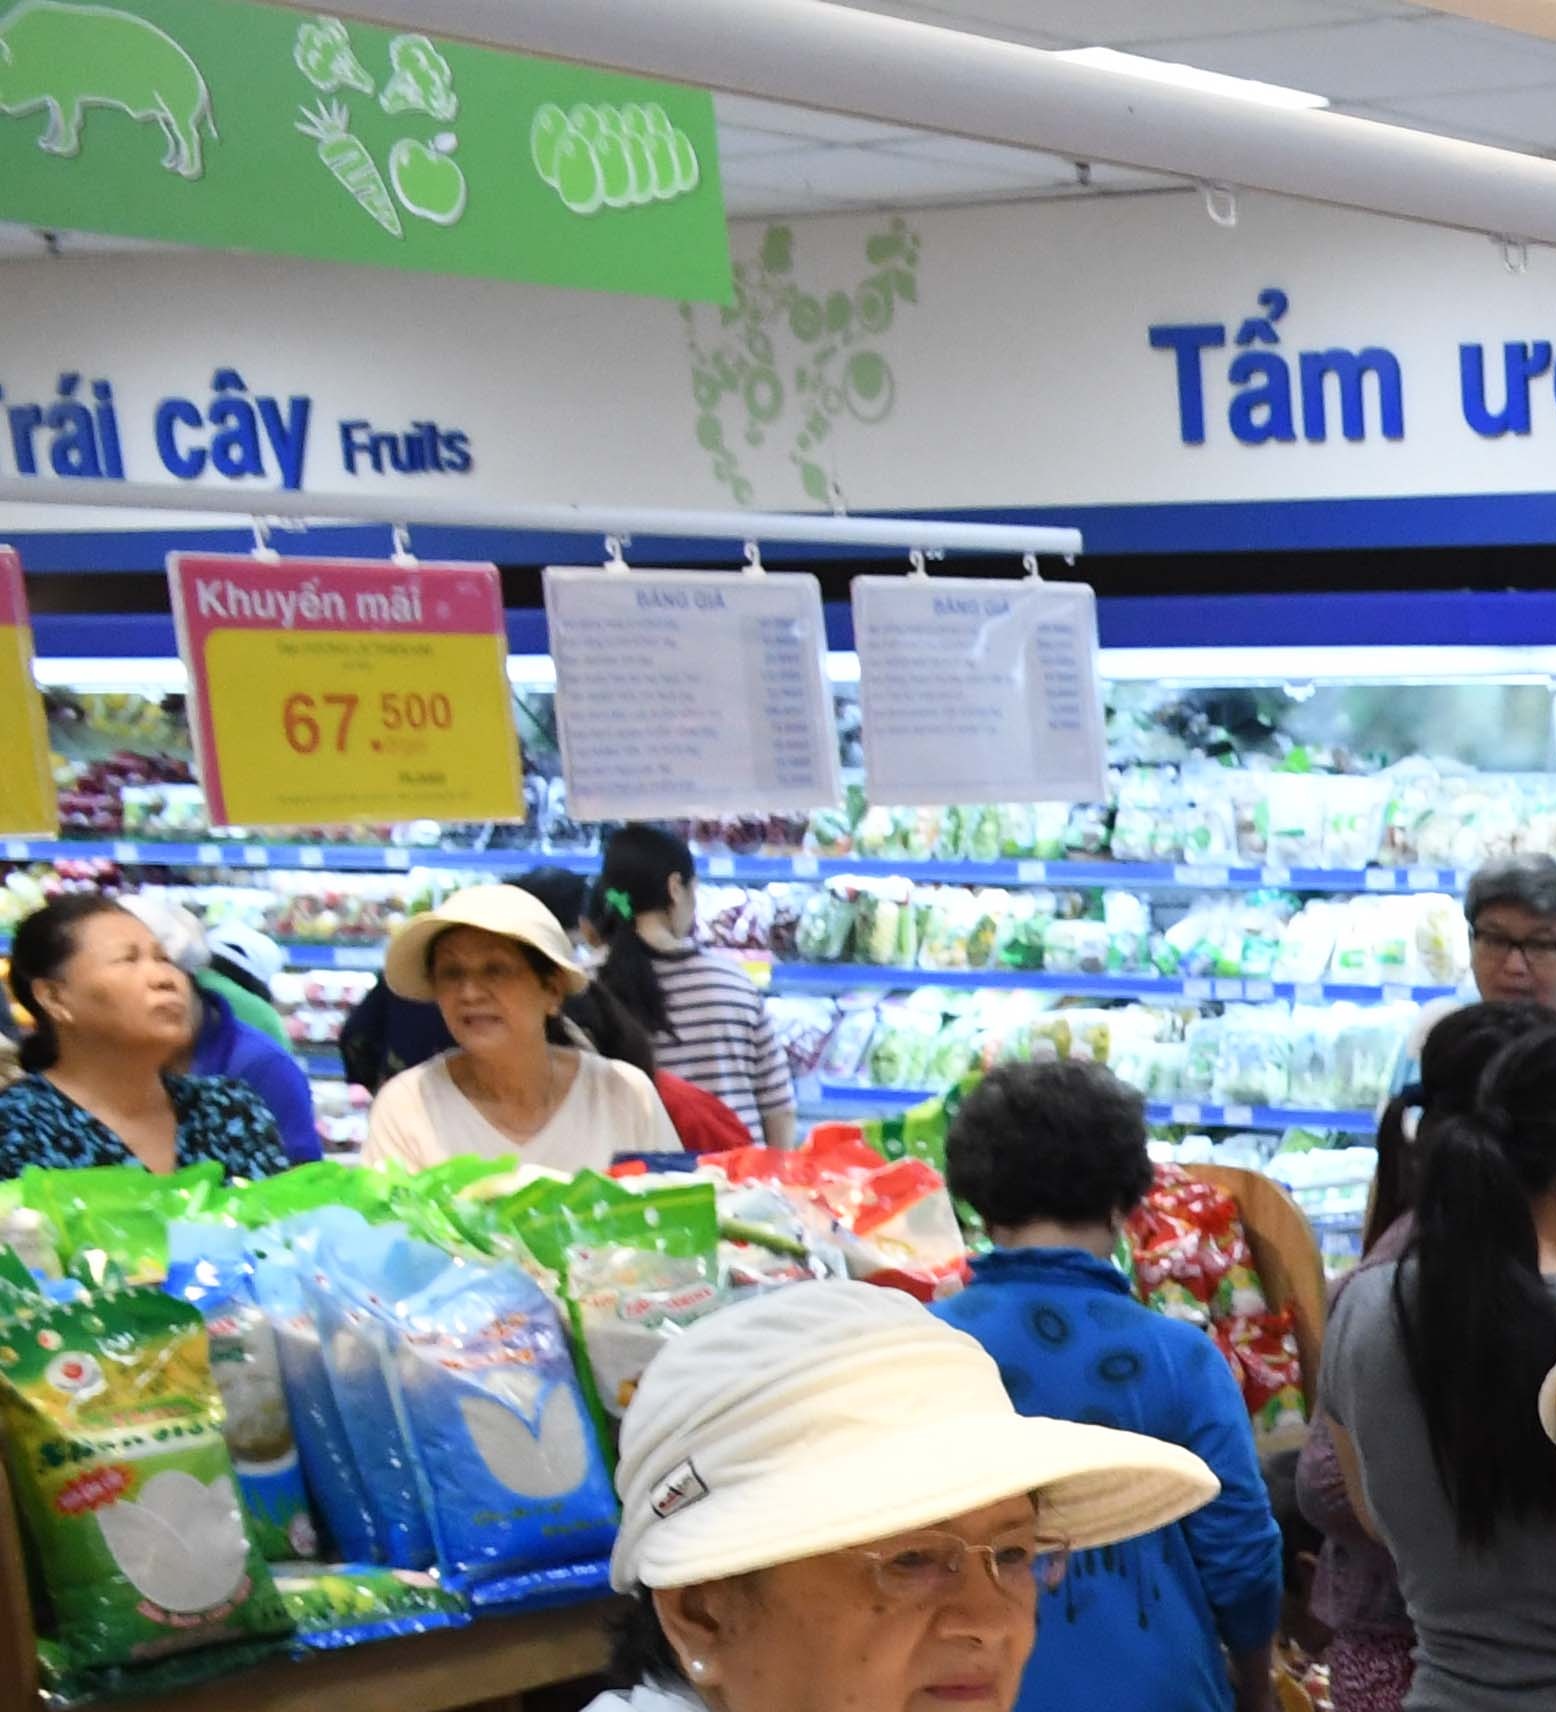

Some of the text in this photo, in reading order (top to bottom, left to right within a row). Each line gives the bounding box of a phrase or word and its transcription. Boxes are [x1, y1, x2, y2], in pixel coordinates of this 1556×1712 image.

[0, 367, 475, 491] rái cây Fruits
[1148, 288, 1404, 446] Tẩm
[196, 576, 422, 630] Khuyến mãi
